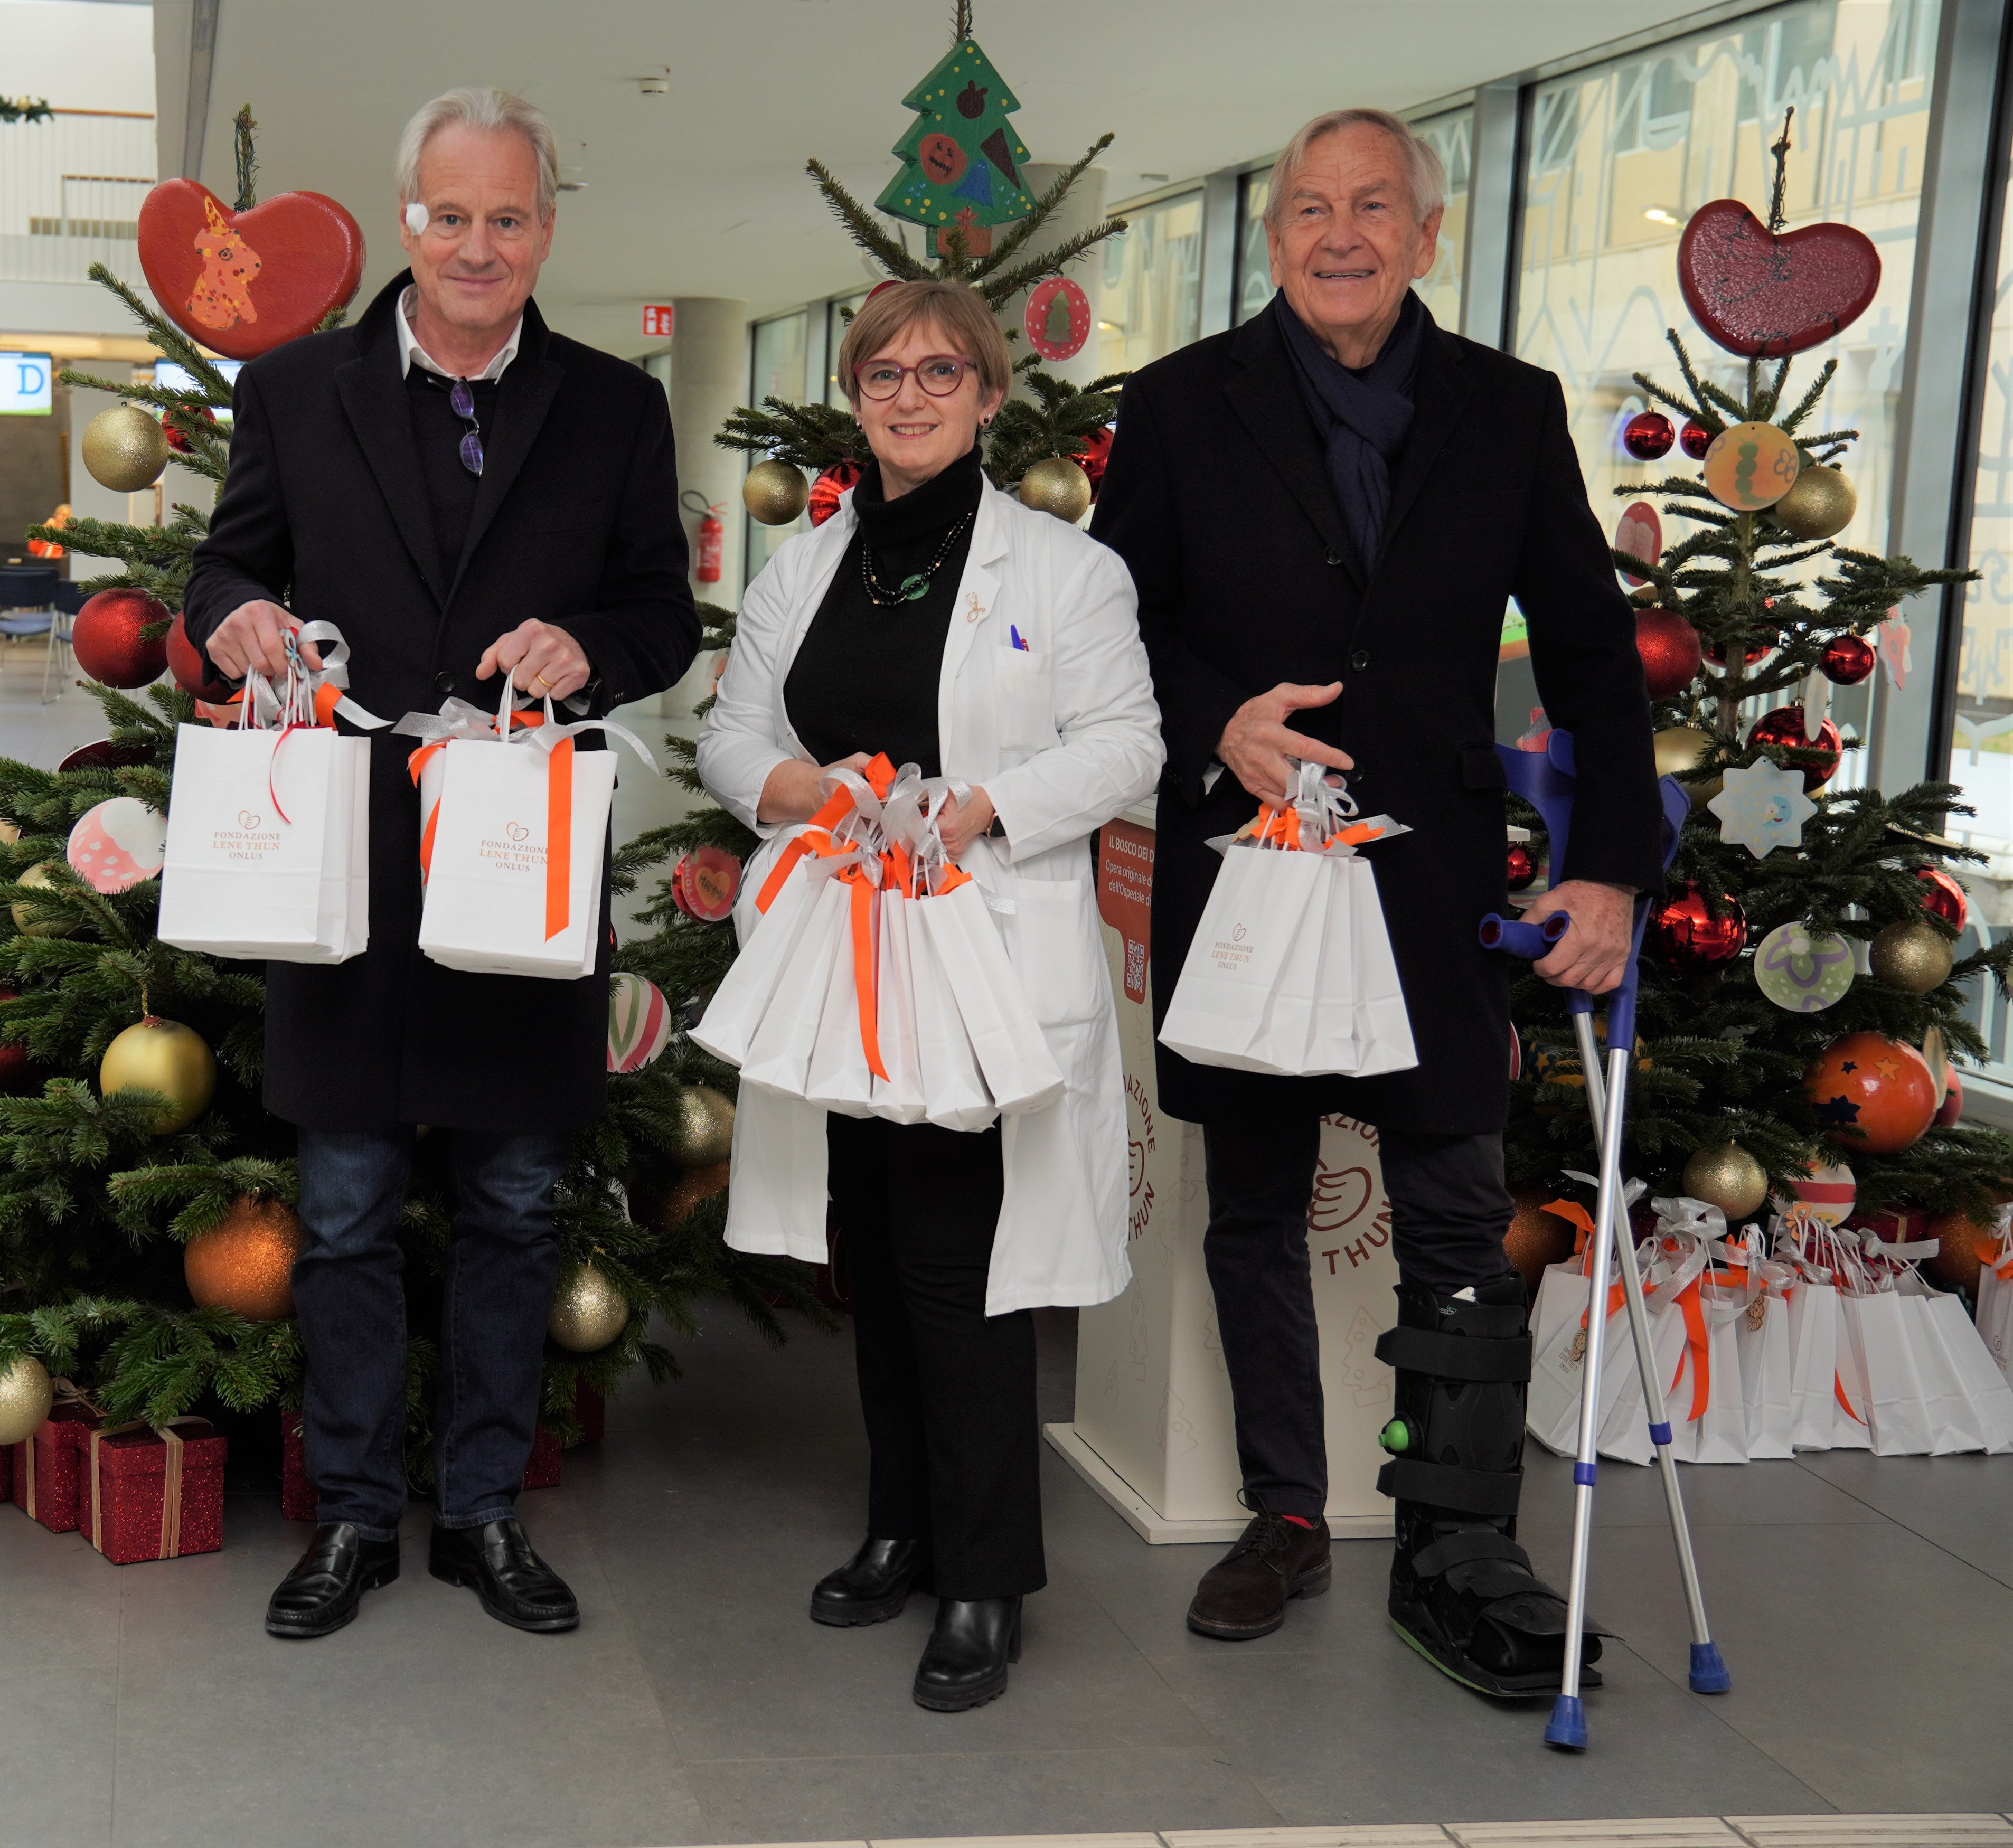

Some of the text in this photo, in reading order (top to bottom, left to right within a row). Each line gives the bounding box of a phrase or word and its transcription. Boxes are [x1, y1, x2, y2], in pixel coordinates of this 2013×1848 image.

[17, 364, 44, 395] D
[213, 841, 280, 850] LENE THUN
[481, 840, 548, 854] FONDAZION
[1109, 835, 1115, 848] IL
[1115, 836, 1136, 856] BOSCO
[1137, 845, 1148, 861] DEI
[479, 848, 510, 860] LENE
[496, 861, 530, 872] ONLUS
[1105, 859, 1122, 875] Opera
[1123, 866, 1146, 885] originale
[1109, 880, 1145, 904] dell'Ospedale
[1215, 941, 1254, 953] FONDAZIONE
[1211, 950, 1250, 963] LENE THUN
[1217, 961, 1237, 970] ONLUS
[1123, 1073, 1155, 1154] AZIONE
